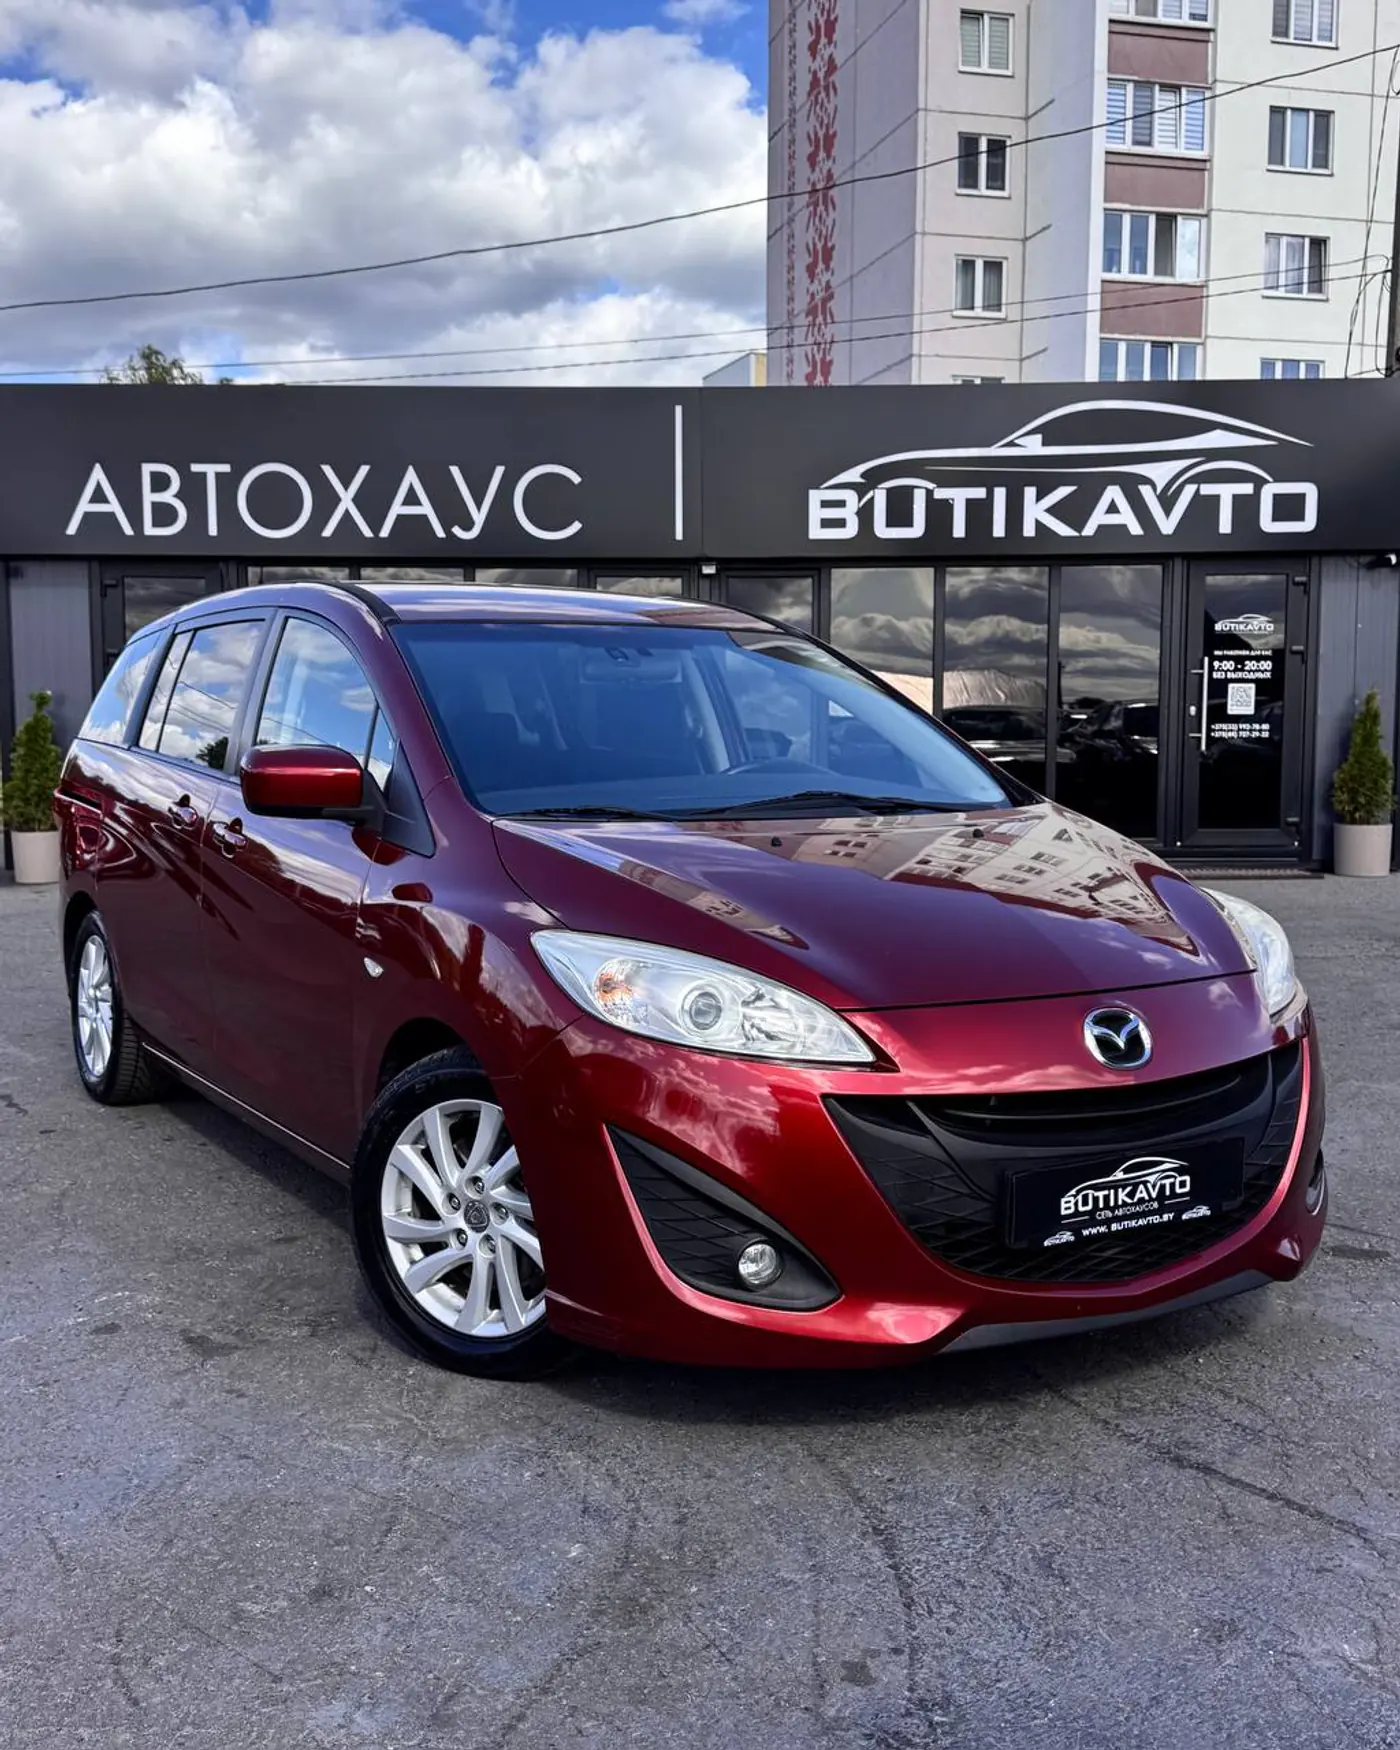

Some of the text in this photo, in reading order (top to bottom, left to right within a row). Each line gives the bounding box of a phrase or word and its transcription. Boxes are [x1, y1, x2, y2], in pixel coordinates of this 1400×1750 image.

[65, 462, 583, 541] АВТОХАУС
[807, 481, 1319, 541] BUTIKAVTO
[1214, 623, 1274, 631] BUTIKAVTO
[1212, 660, 1235, 671] 9:00
[1243, 660, 1273, 671] 20:00
[1212, 671, 1226, 679] БЕЗ
[1060, 1175, 1191, 1216] BUTIKAVTO
[1081, 1212, 1175, 1237] WWW. BUTIKAVTO.BY
